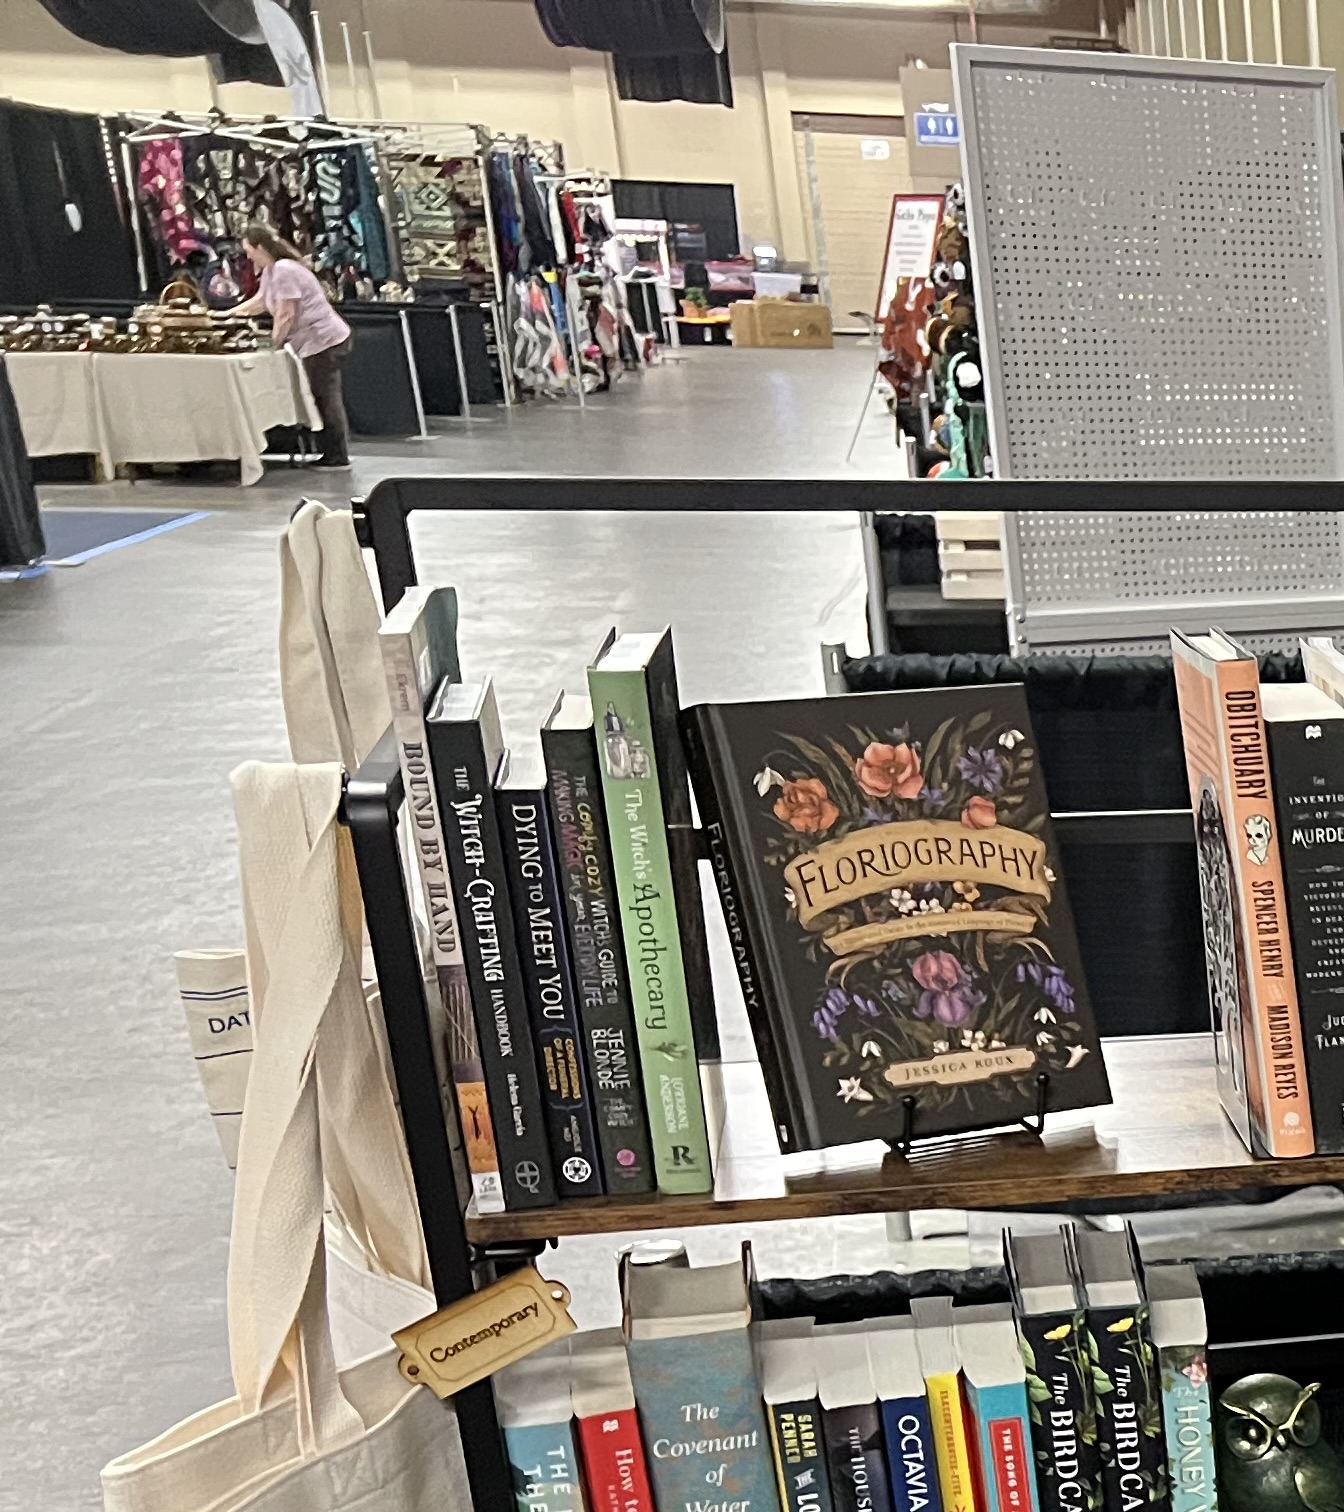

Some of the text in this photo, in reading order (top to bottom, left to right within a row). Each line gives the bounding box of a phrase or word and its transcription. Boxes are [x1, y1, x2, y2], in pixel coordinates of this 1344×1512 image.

[1223, 689, 1269, 800] OBITCHUARY
[794, 835, 1041, 907] FLORIOGRAPHY
[707, 822, 760, 1008] FLORIOGRAPHY
[904, 1054, 1014, 1080] JESSICA ROUX
[429, 1301, 541, 1364] Contemporary
[1050, 1372, 1069, 1405] The
[1112, 1364, 1131, 1398] The
[680, 1403, 719, 1423] The
[653, 1430, 758, 1458] Covenant
[705, 1464, 726, 1488] of
